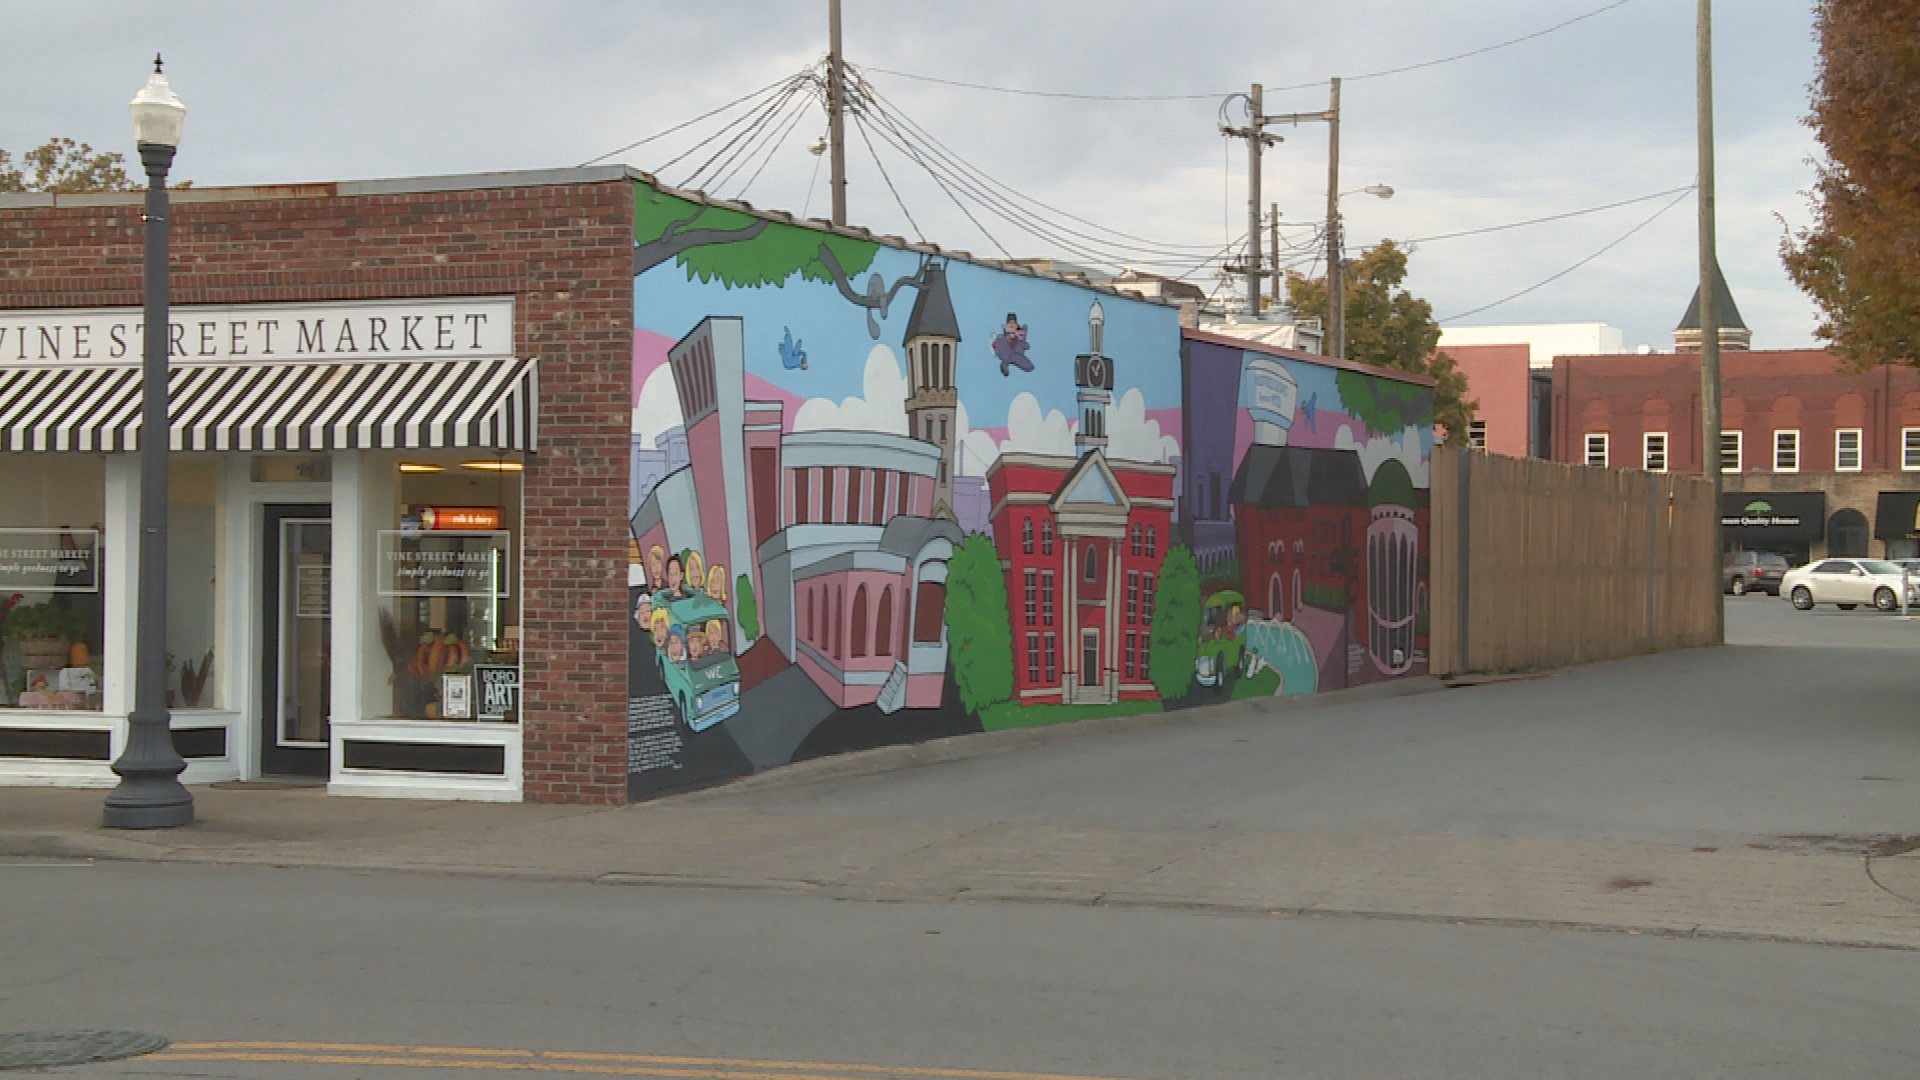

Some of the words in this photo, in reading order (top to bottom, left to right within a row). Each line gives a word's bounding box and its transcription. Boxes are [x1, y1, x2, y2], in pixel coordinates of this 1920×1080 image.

[296, 313, 488, 354] MARKET
[11, 549, 48, 559] STREET
[50, 549, 90, 559] MARKET
[386, 551, 413, 561] VINE
[415, 551, 455, 562] STREET
[457, 551, 503, 562] MARKET
[705, 665, 723, 679] WC
[485, 683, 515, 705] ART
